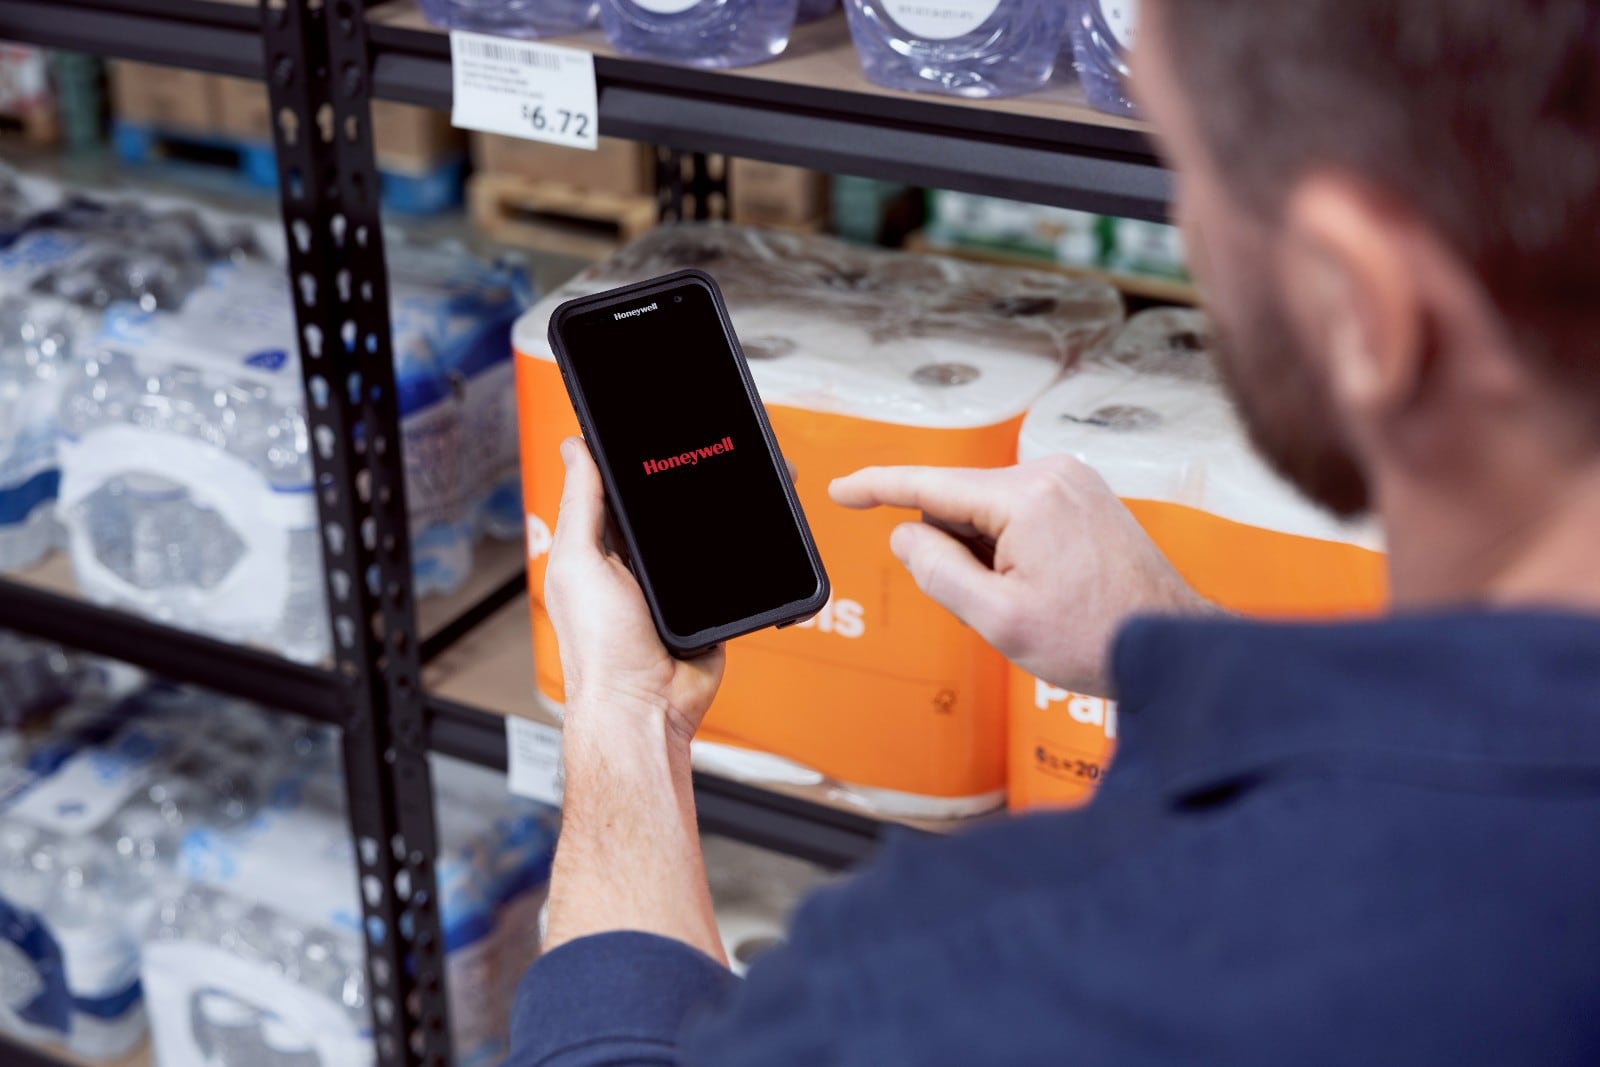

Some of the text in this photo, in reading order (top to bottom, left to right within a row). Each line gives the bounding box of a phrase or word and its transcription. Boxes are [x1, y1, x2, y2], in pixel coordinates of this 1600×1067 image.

[521, 103, 589, 139] $6.72
[613, 302, 658, 320] Honeywell
[642, 436, 734, 475] Honeywell
